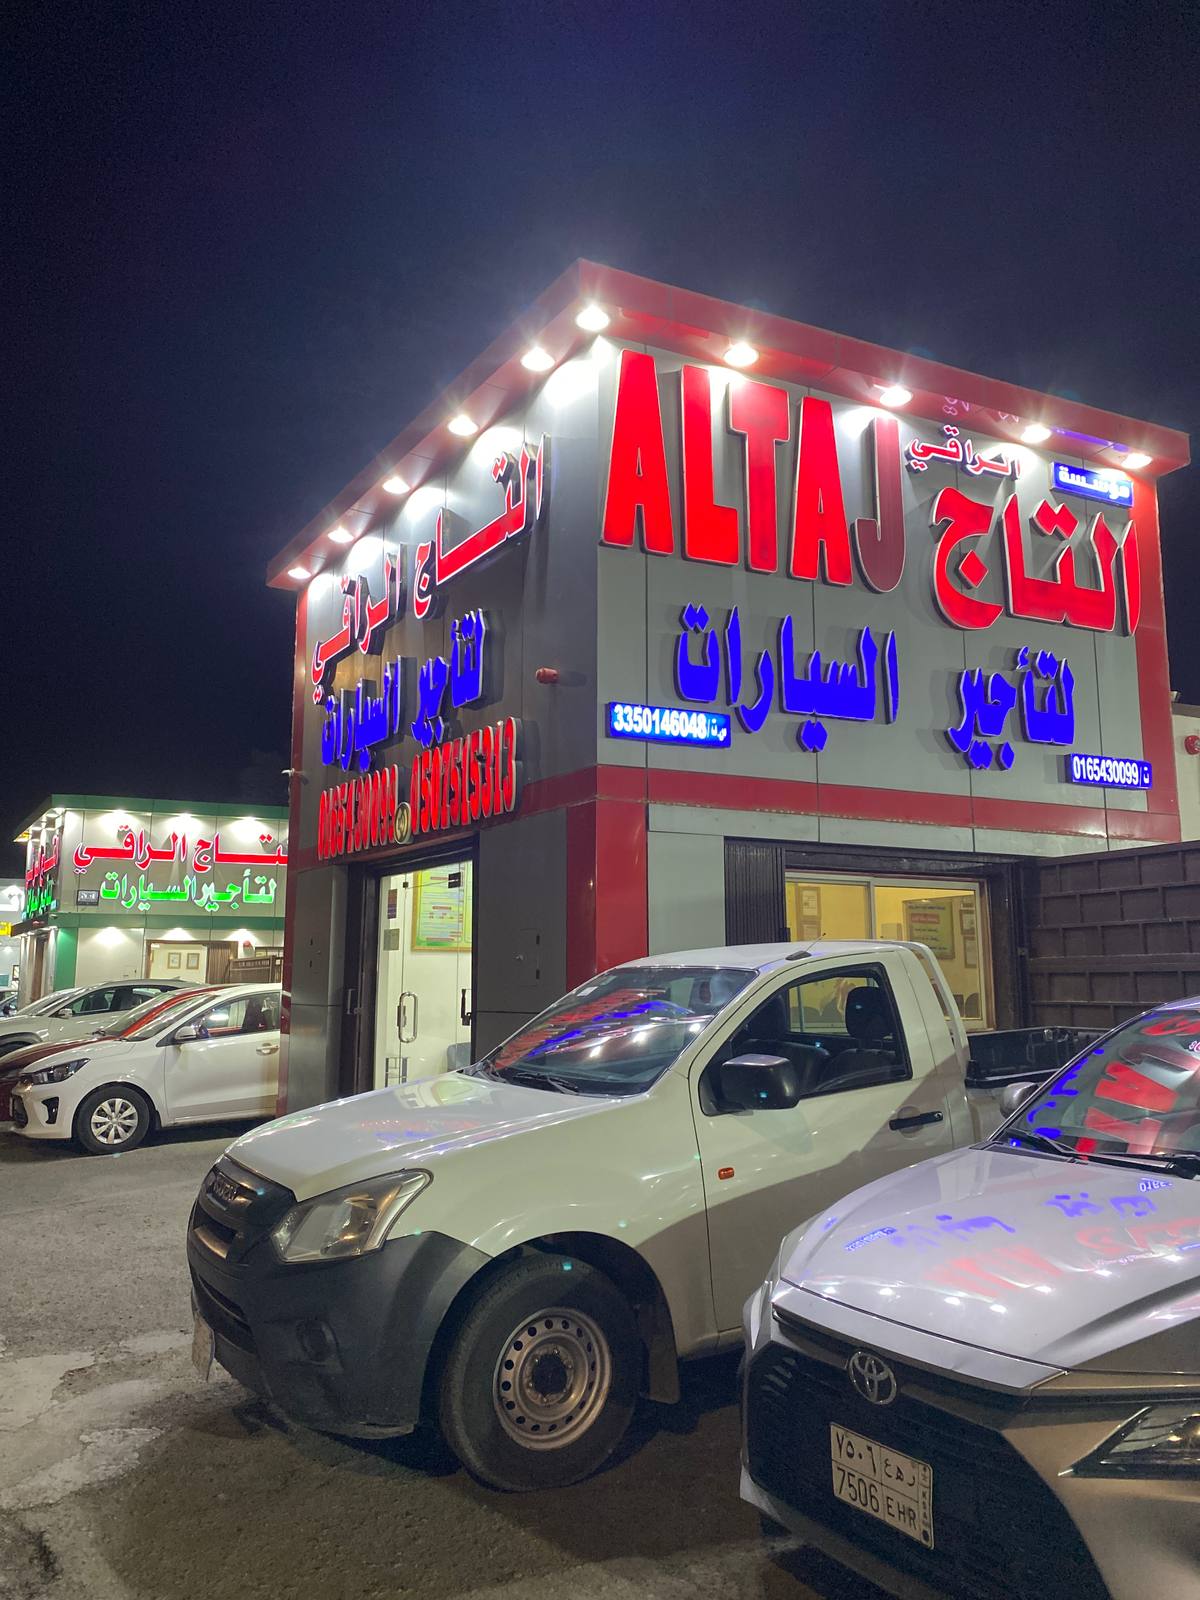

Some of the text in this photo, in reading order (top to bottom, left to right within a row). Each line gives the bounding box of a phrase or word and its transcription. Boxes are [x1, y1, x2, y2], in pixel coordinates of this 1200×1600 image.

[602, 348, 905, 593] ALTAJ
[910, 425, 1021, 478] الراقي
[311, 432, 546, 704] التاج الراقي
[931, 486, 1141, 636] التاج
[321, 655, 400, 772] السيارات
[676, 602, 1075, 770] لتأجير السيارات
[73, 823, 188, 875] الراقي
[100, 871, 197, 911] السيارات
[836, 1467, 918, 1530] 7506 EHR
